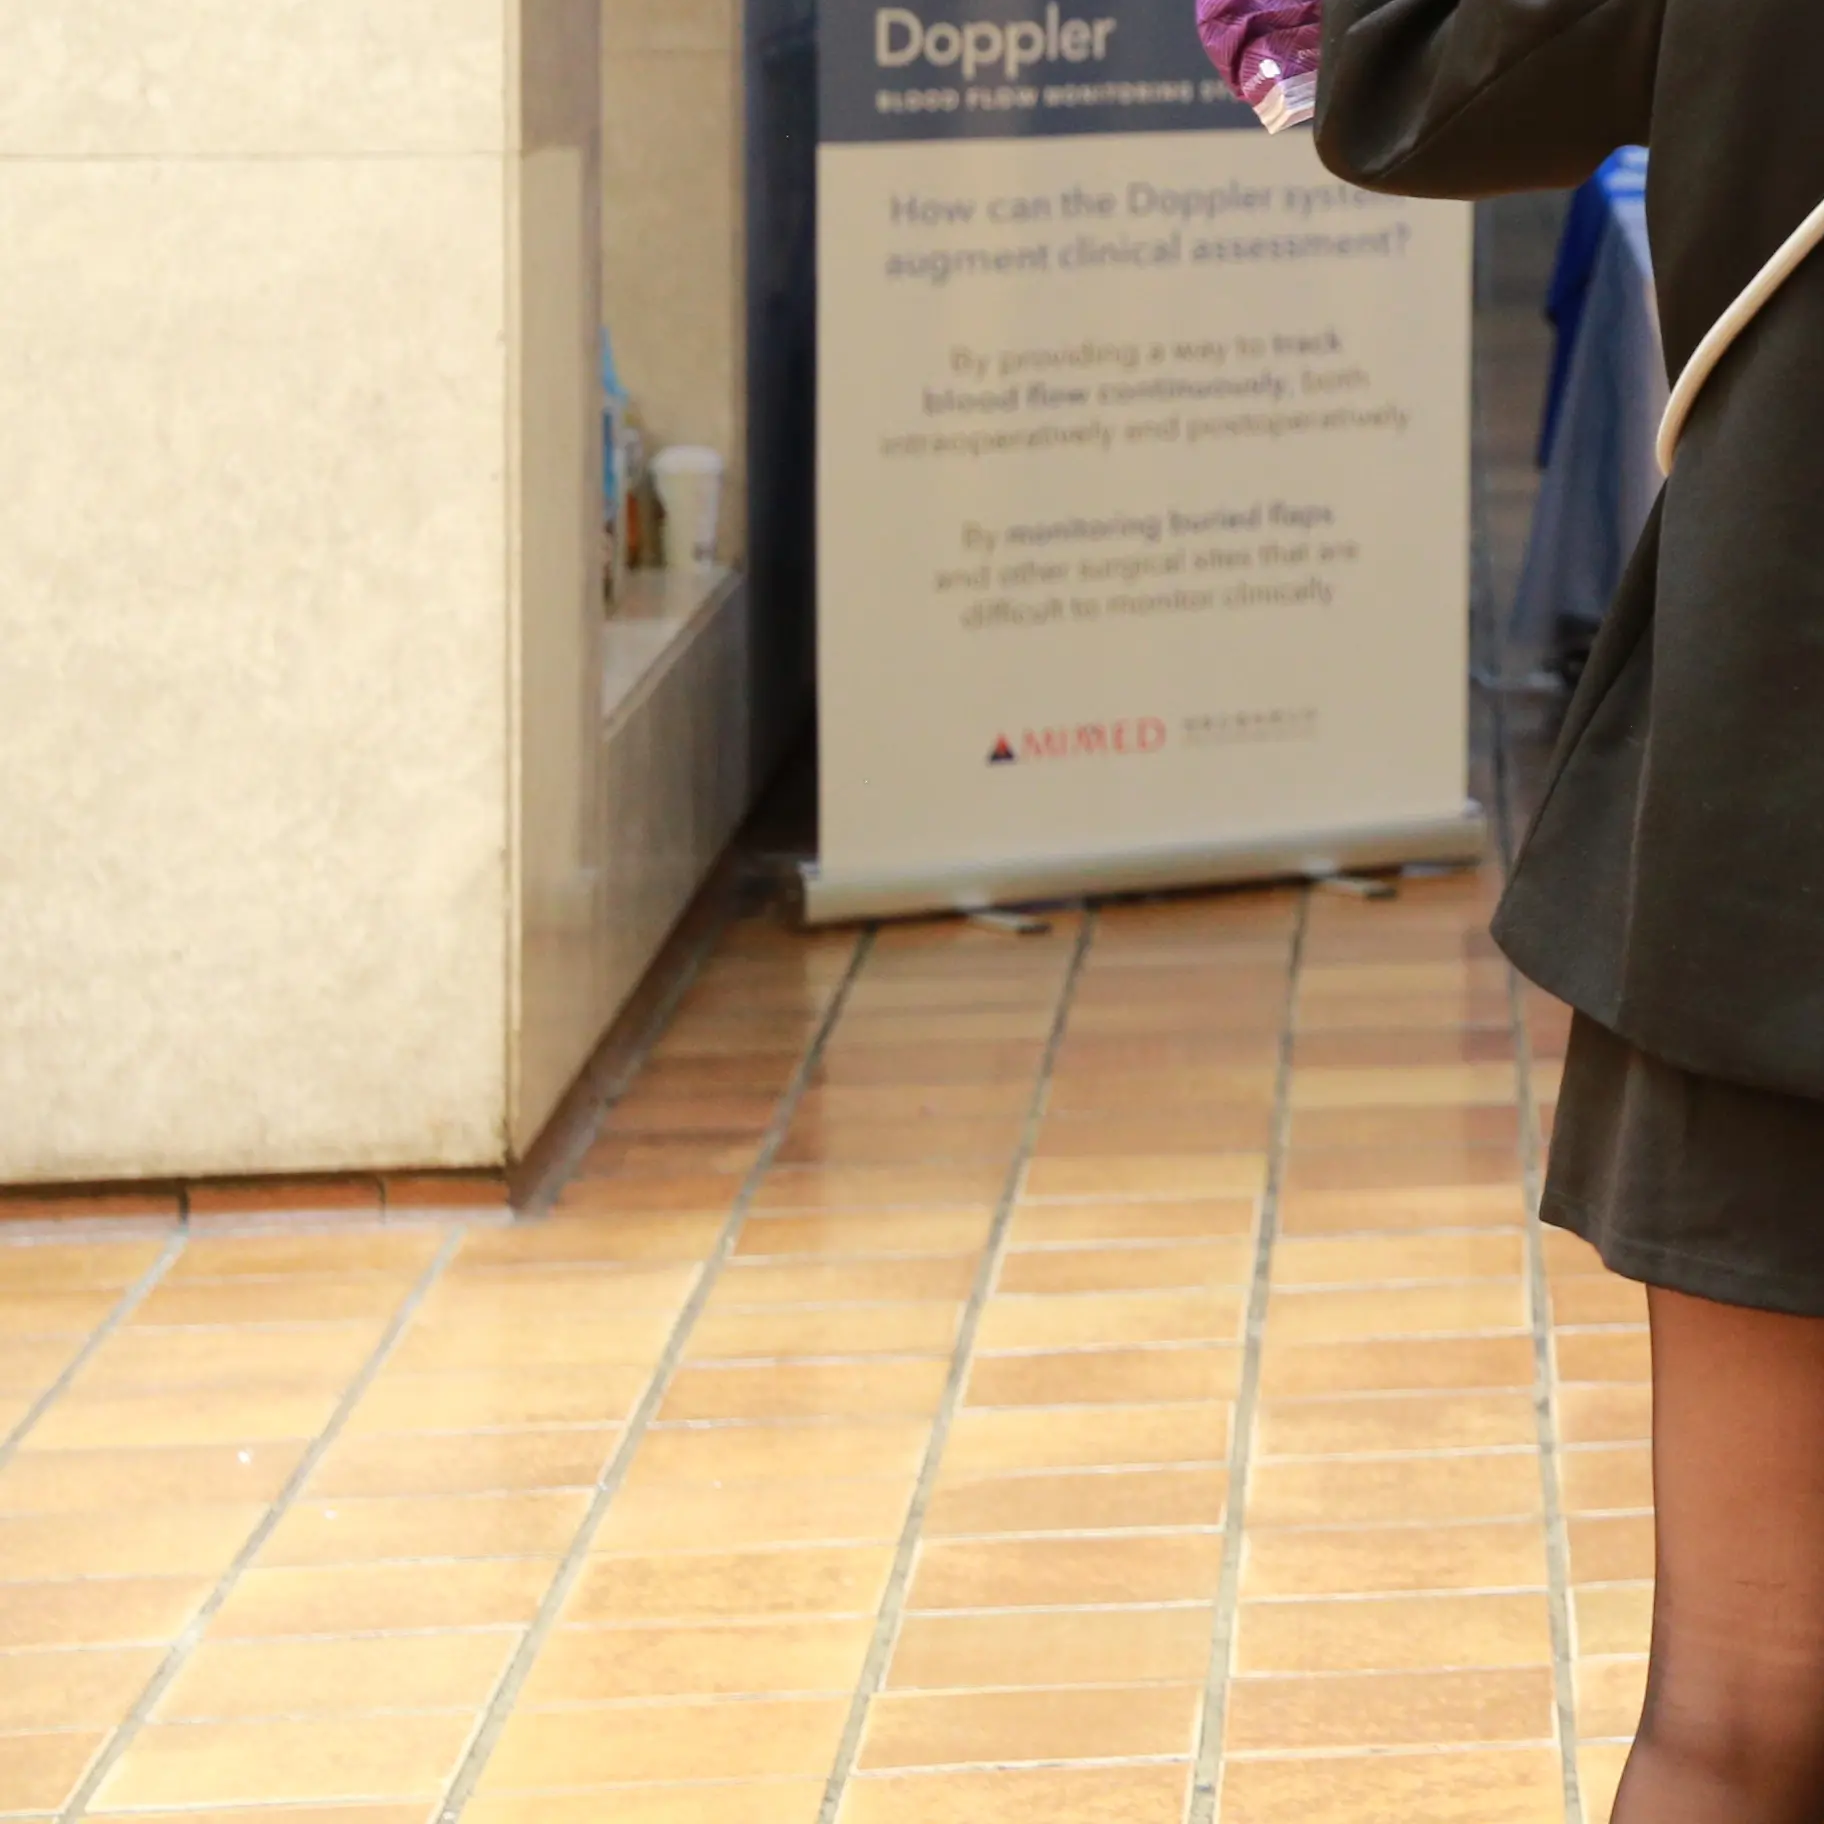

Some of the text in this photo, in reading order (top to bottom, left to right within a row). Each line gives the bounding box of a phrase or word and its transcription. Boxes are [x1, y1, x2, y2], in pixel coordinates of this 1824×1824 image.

[874, 2, 1116, 79] Doppler
[875, 88, 960, 115] BLOOD
[965, 85, 1039, 112] FLOW
[888, 191, 976, 226] How
[988, 193, 1052, 223] can
[1061, 182, 1118, 218] the
[1127, 179, 1271, 225] Doppler
[885, 223, 1411, 287] augment clinical assessment?
